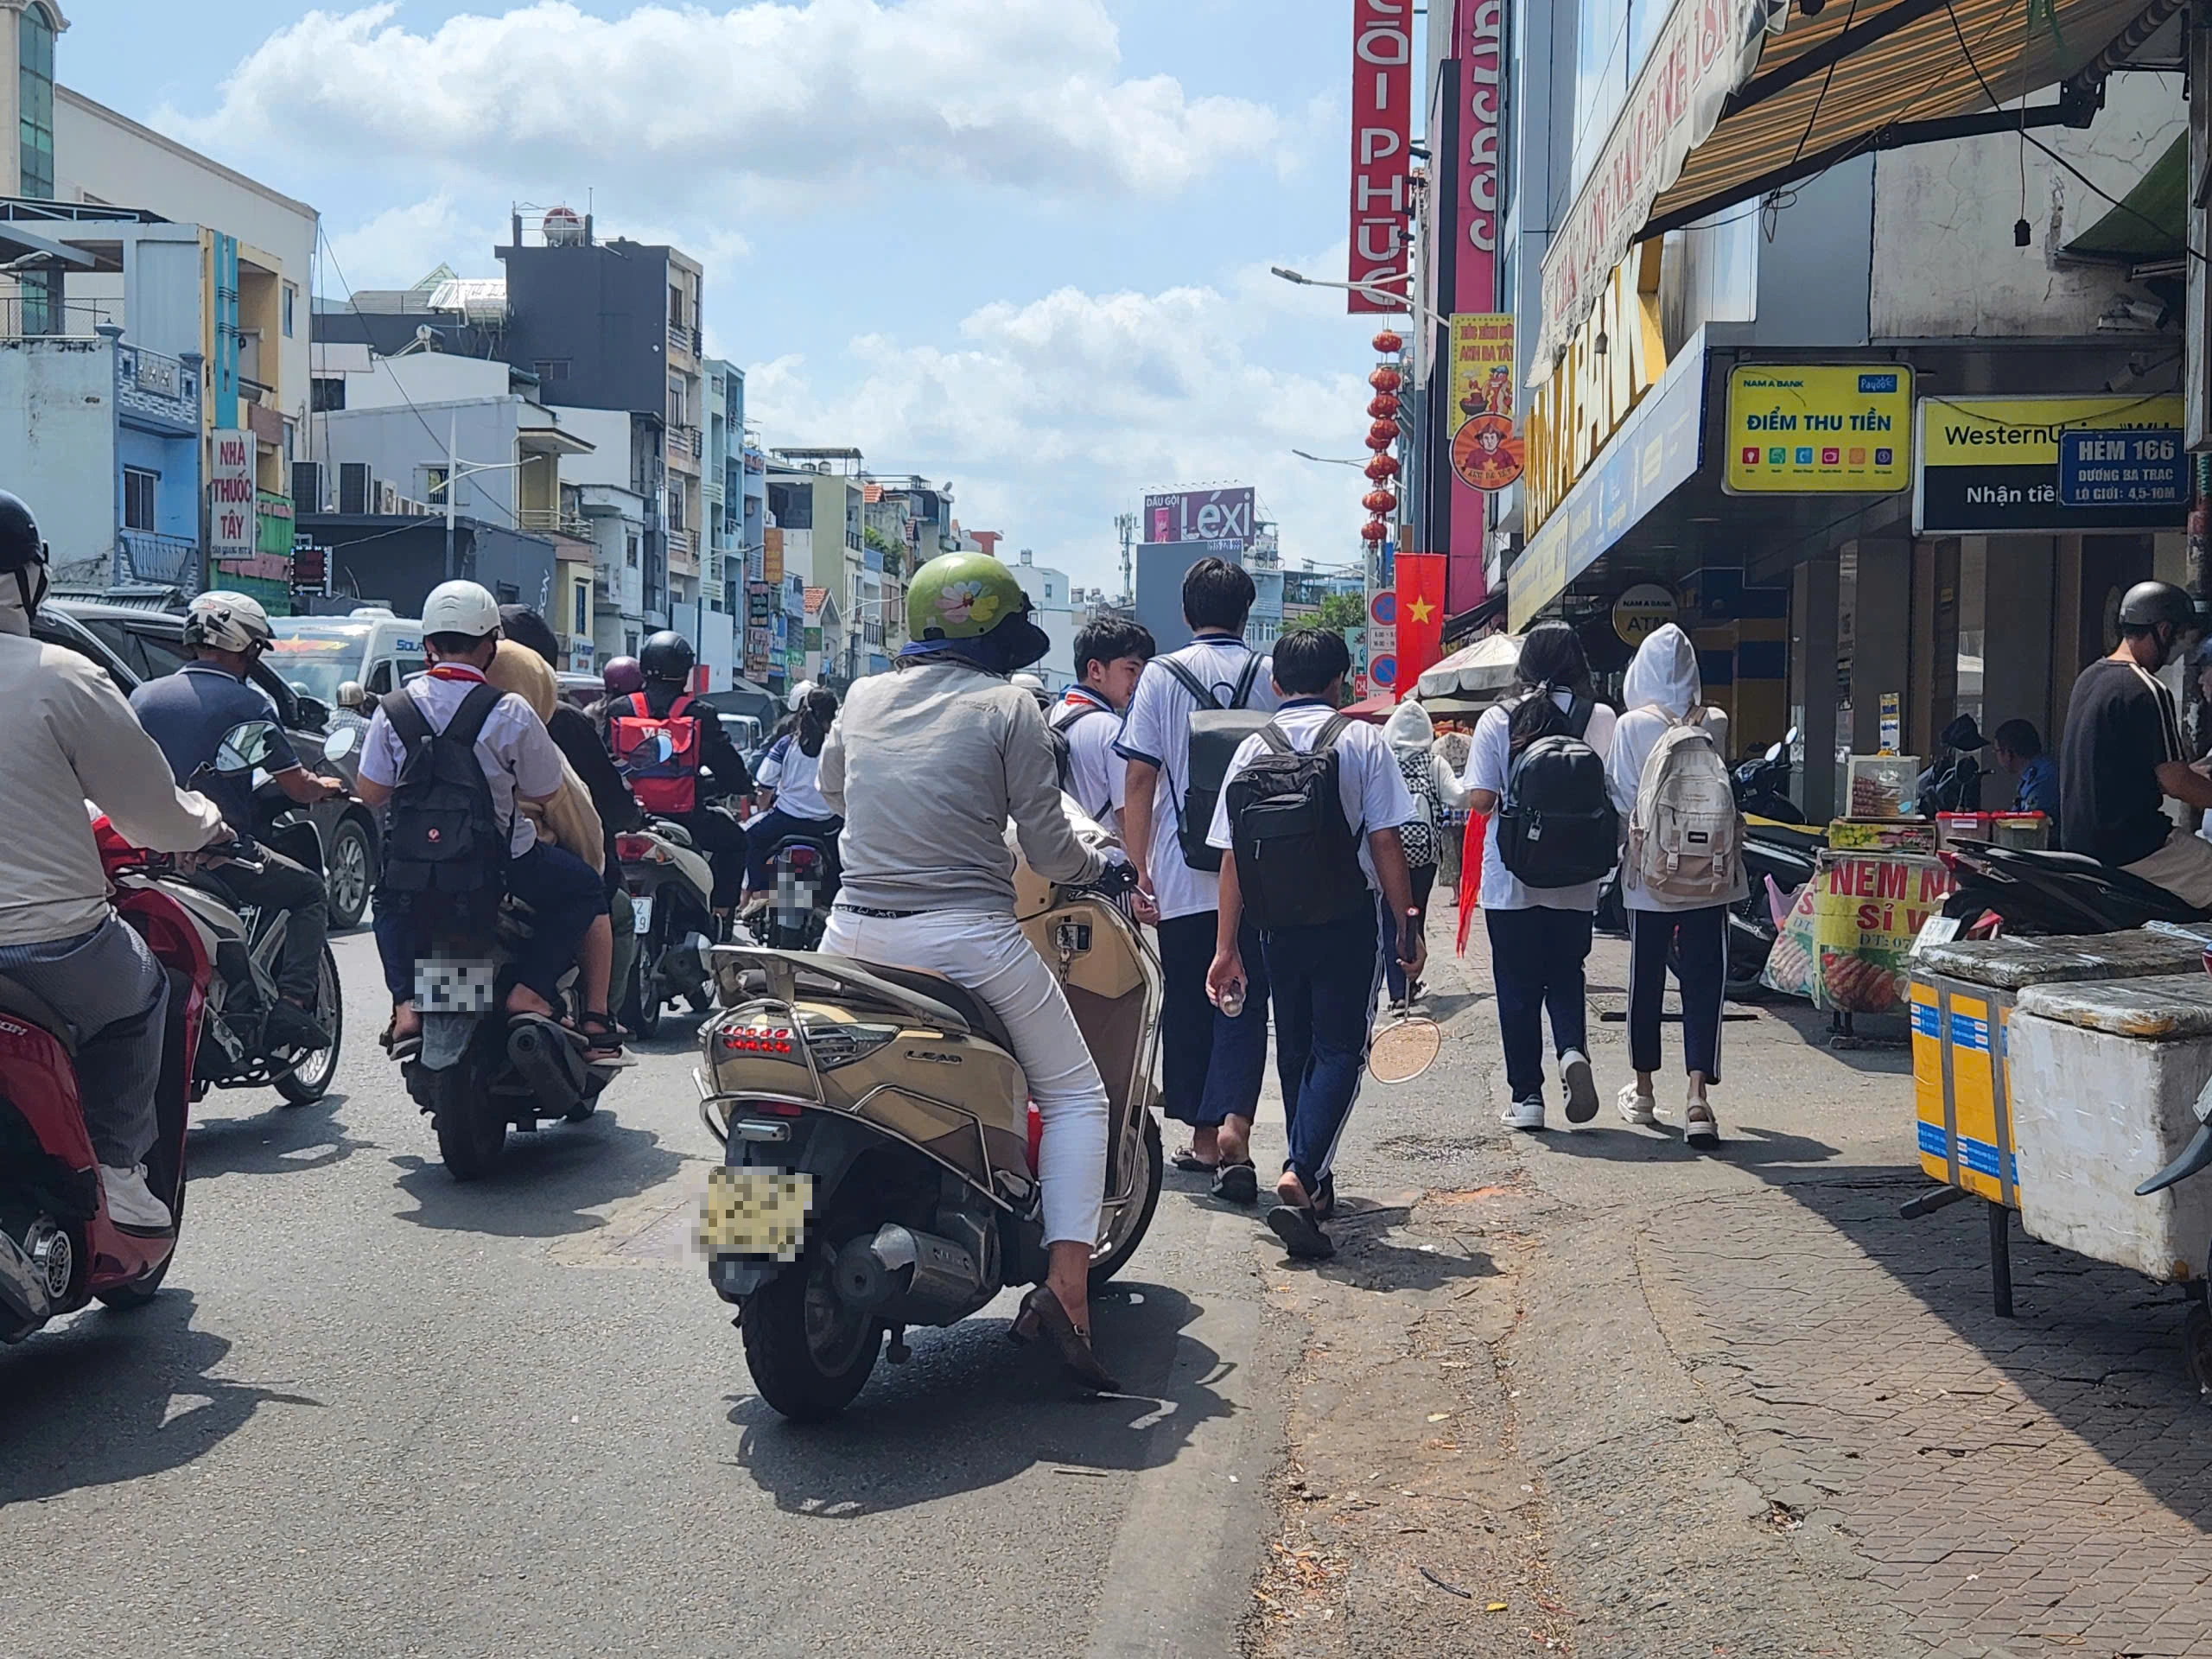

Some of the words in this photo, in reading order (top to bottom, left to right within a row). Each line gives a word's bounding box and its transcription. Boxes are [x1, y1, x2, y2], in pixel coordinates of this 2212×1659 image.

[1572, 240, 1664, 480] BANK
[1861, 378, 1887, 391] Payoo
[1747, 406, 1797, 430] ĐIỂM
[1804, 415, 1843, 430] THU
[1849, 407, 1891, 430] TIỀN
[219, 436, 246, 466] NHÀ
[2132, 439, 2175, 461] 166
[213, 470, 251, 502] THUỐC
[1967, 486, 2022, 508] Nhận
[2028, 483, 2059, 503] tiề
[220, 509, 244, 539] TÂY
[1180, 490, 1251, 541] Léxi
[396, 639, 423, 652] SOLA
[1829, 860, 1909, 900] NEM
[1797, 892, 1814, 915] S
[1857, 903, 1894, 931] SỈ
[1906, 909, 1929, 935] V
[1892, 937, 1912, 950] 07
